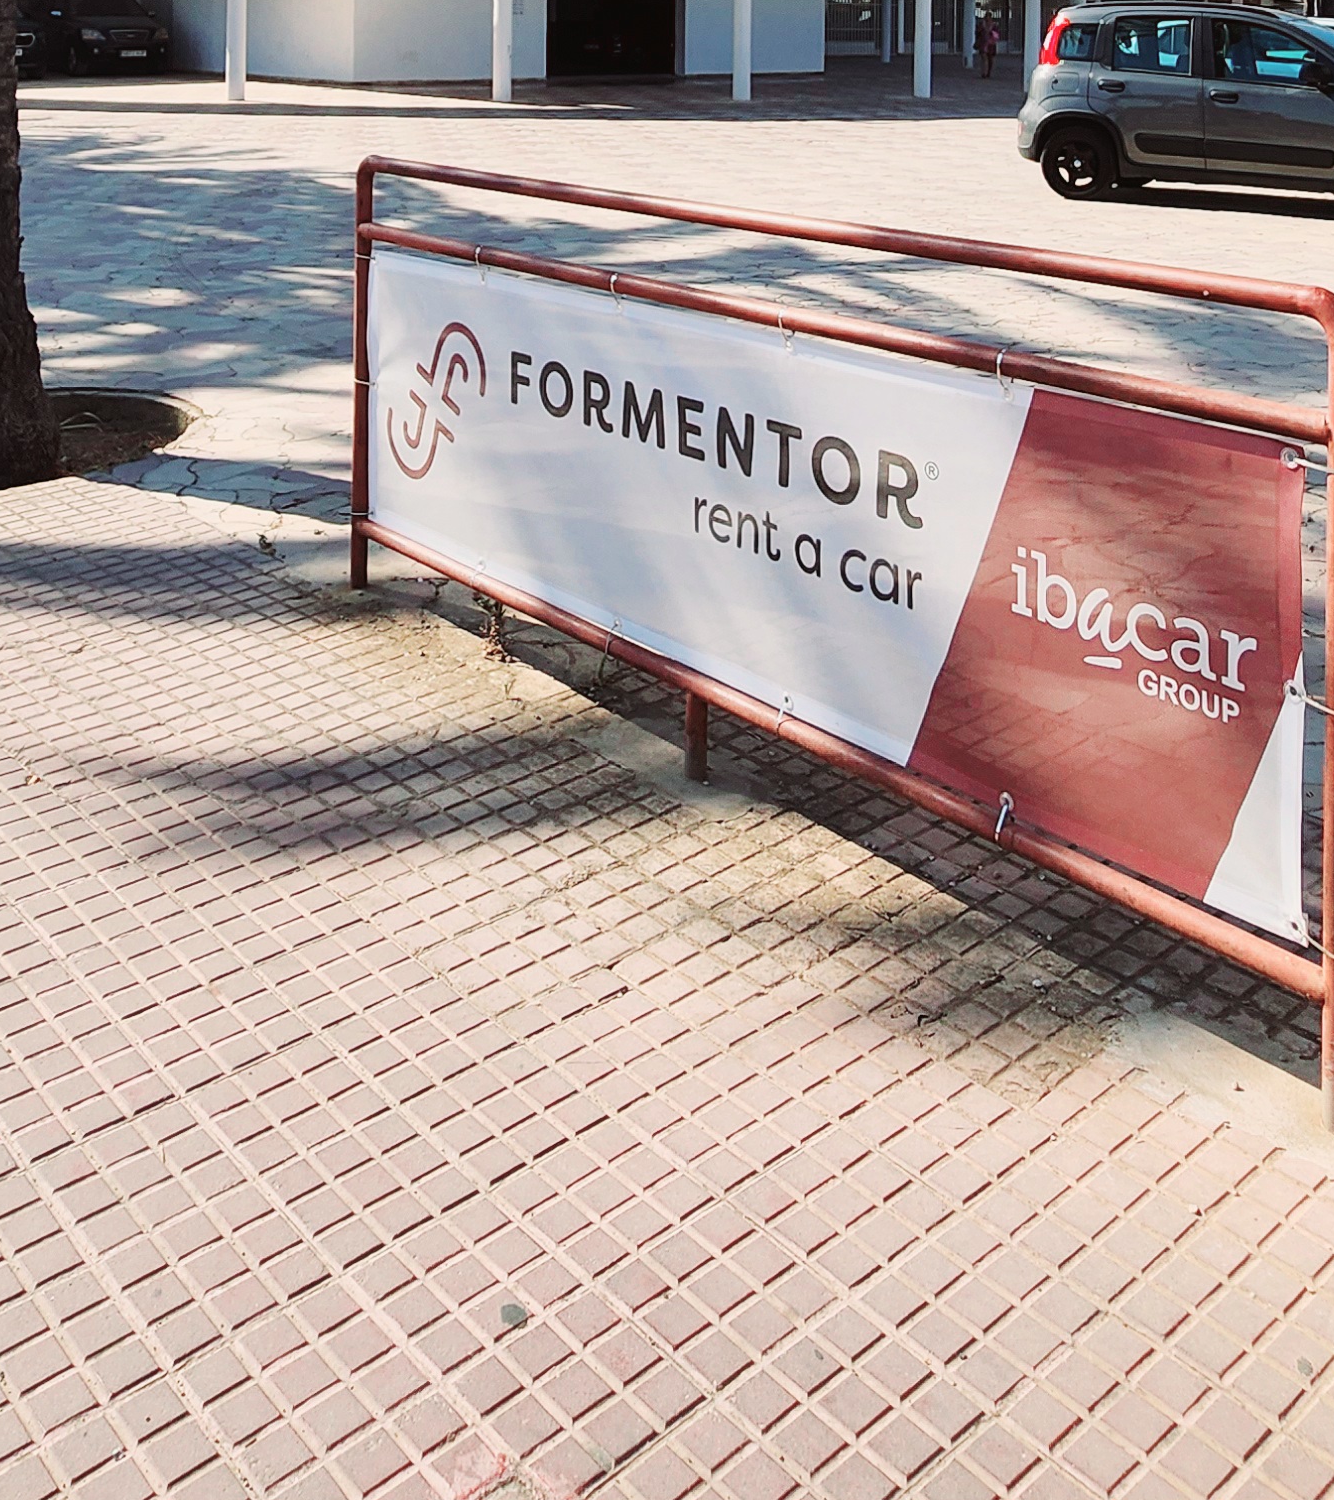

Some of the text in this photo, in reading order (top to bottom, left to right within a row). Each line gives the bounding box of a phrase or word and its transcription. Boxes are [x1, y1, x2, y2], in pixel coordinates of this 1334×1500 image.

[510, 351, 924, 529] FORMENTOR
[694, 496, 922, 610] rent a car
[1010, 546, 1258, 692] ibacar
[1137, 669, 1240, 723] GROUP
